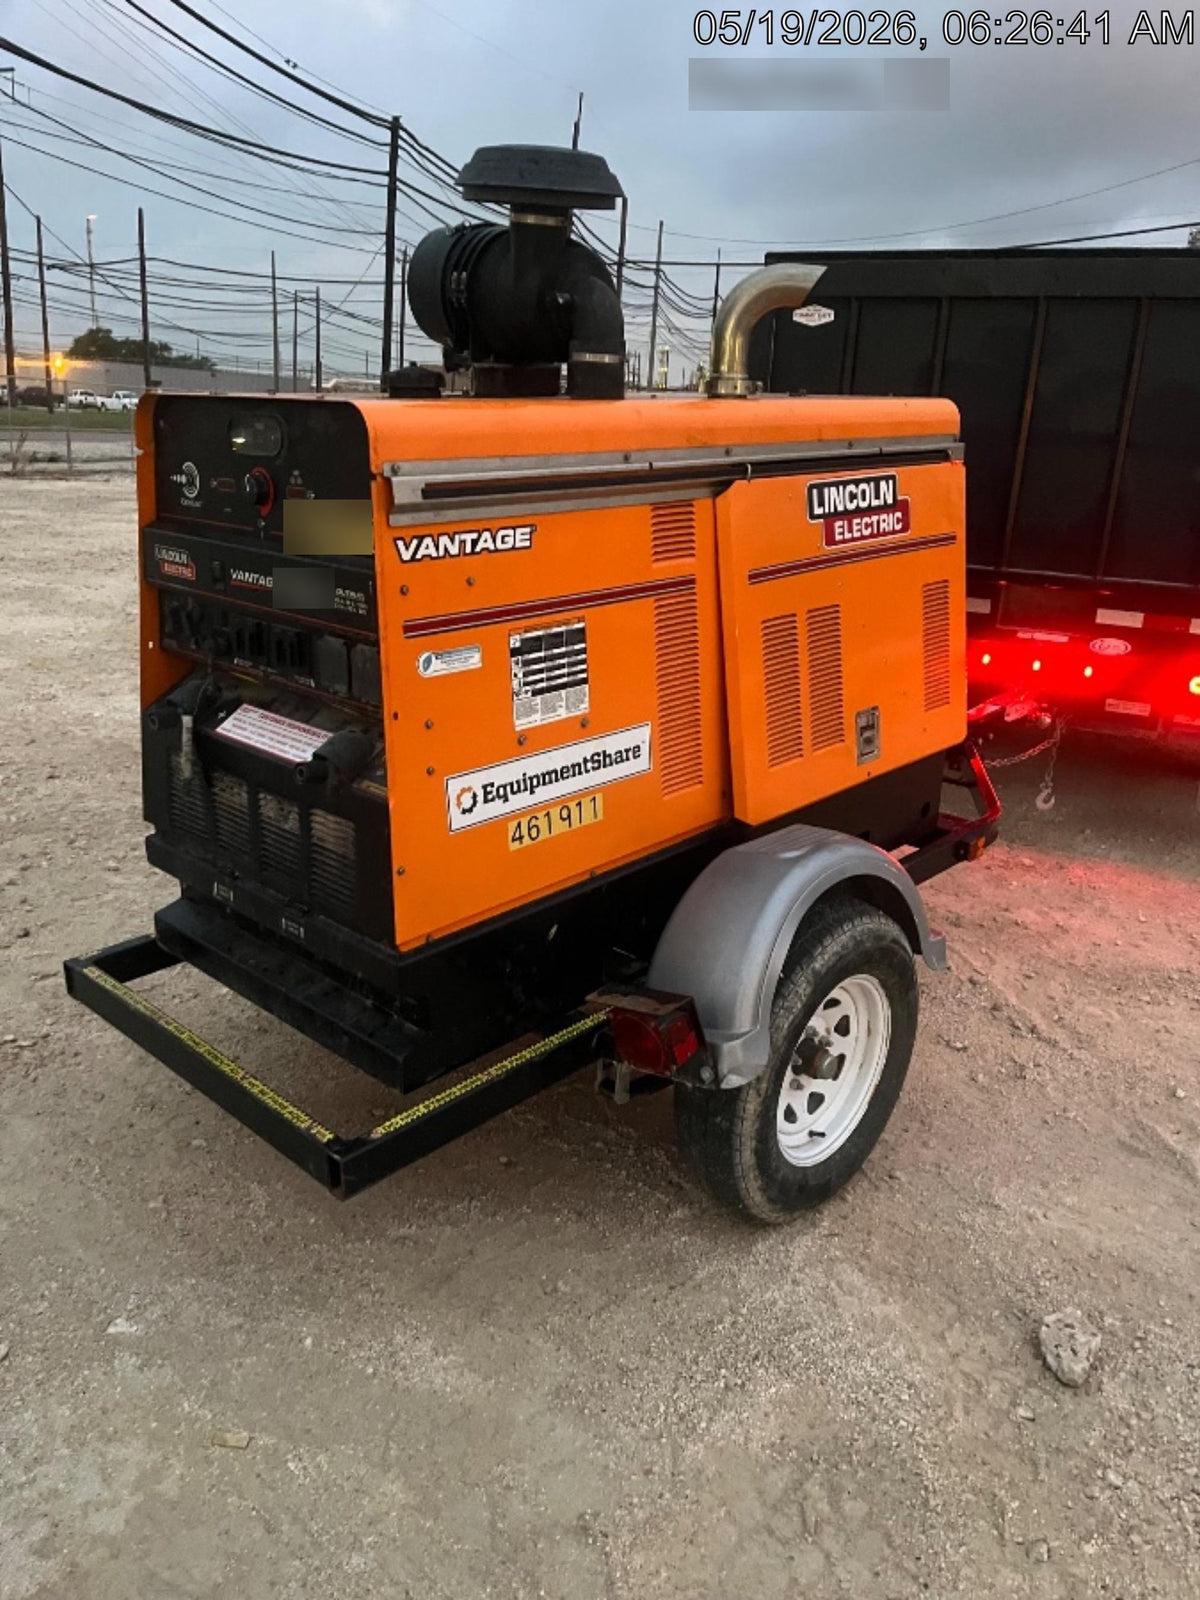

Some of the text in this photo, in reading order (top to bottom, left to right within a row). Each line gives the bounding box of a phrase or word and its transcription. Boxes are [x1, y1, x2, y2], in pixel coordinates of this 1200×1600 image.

[811, 479, 894, 515] LINCOLN
[395, 526, 532, 561] VANTAGE
[833, 511, 903, 542] ELECTRIC
[230, 568, 274, 588] VANTAG
[481, 744, 642, 805] EquipmentShare
[511, 796, 599, 845] 461911
